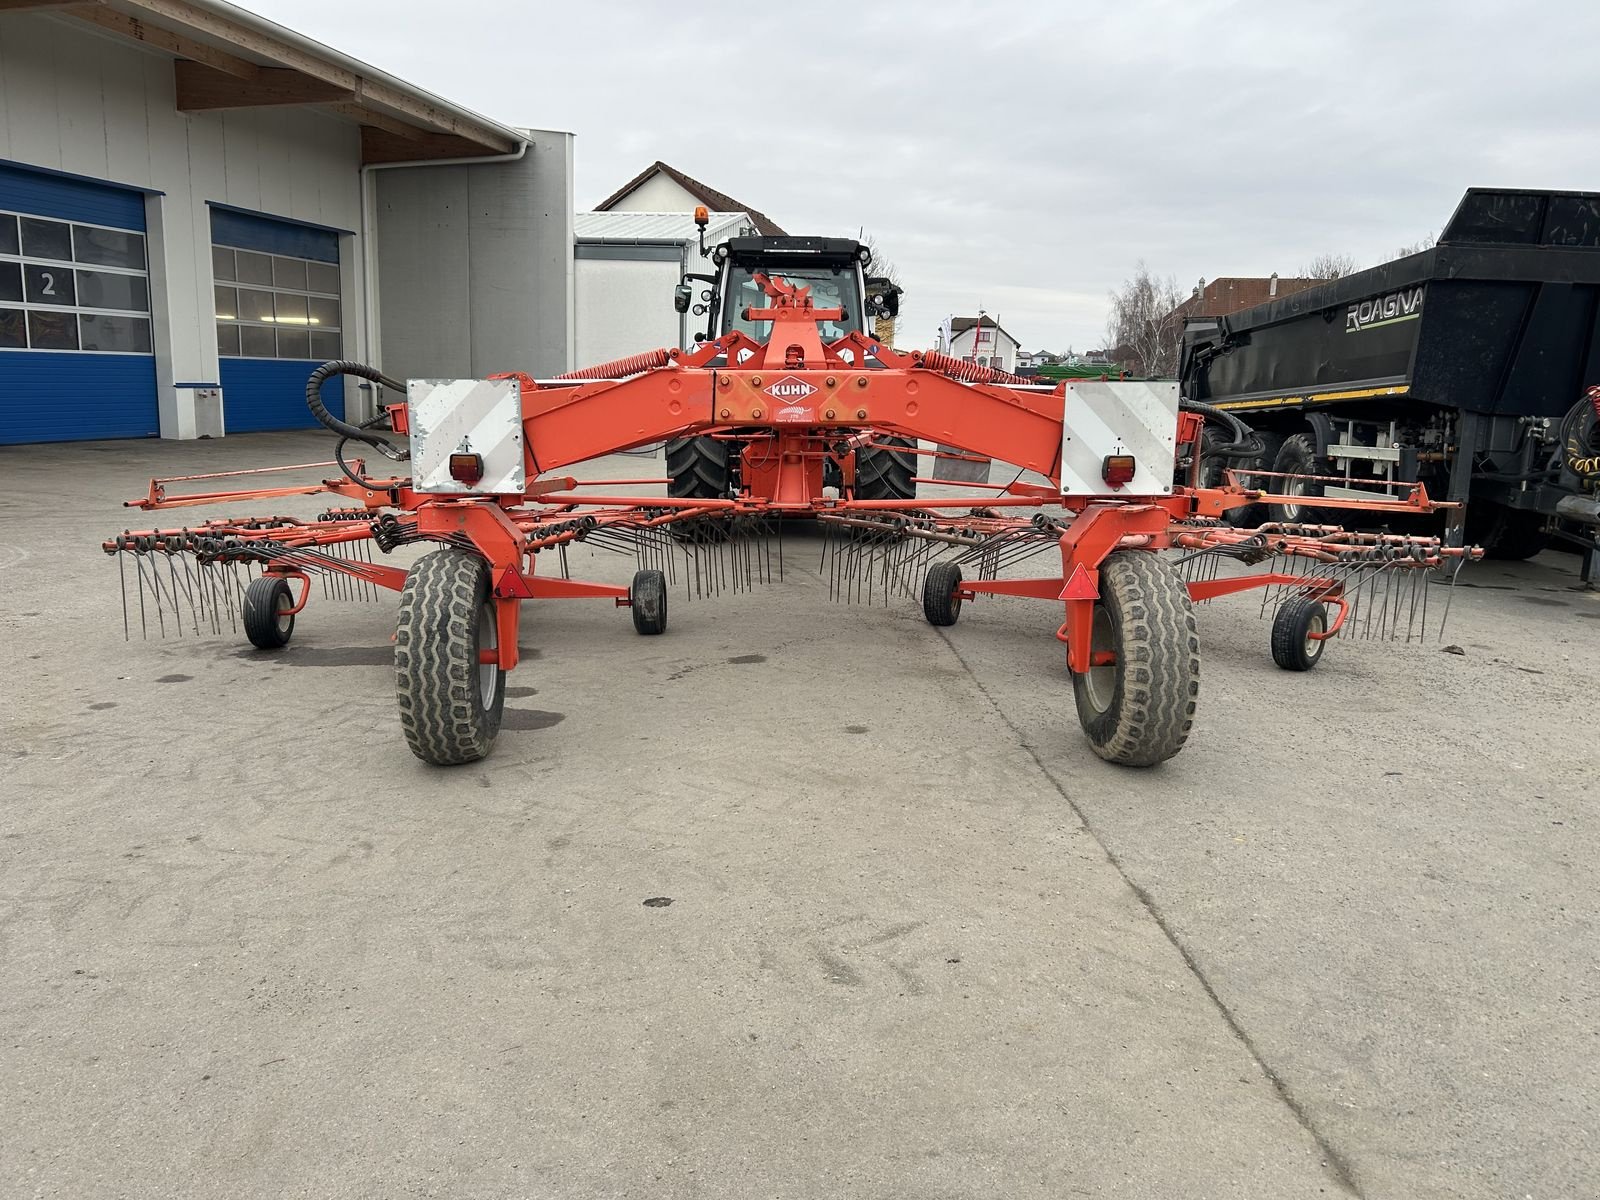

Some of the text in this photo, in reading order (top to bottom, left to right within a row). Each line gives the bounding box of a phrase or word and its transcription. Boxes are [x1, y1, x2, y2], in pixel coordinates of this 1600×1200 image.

[42, 273, 55, 295] 2
[1346, 287, 1424, 331] ROAGNA
[771, 384, 810, 396] KUHN
